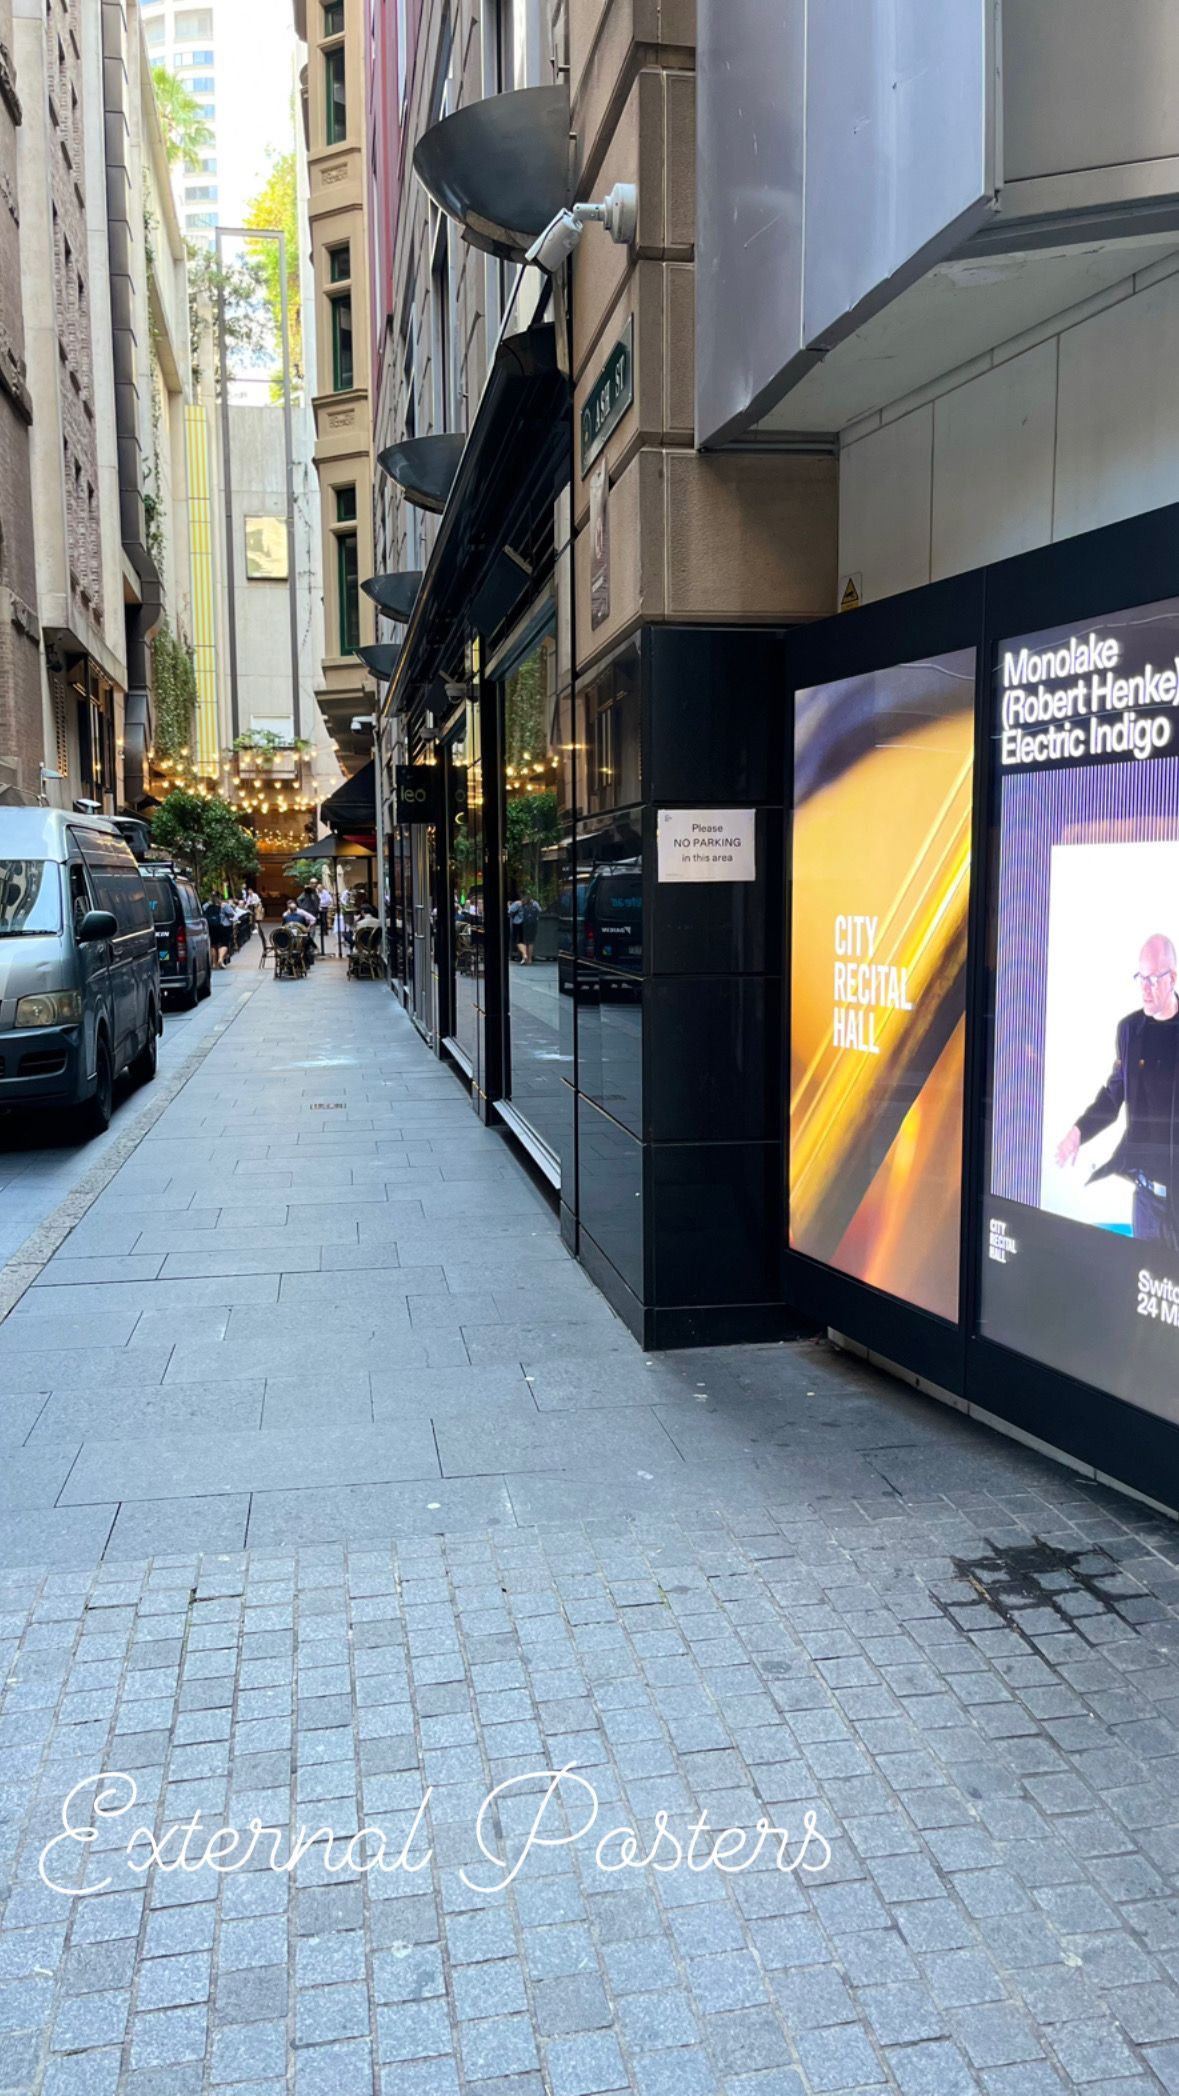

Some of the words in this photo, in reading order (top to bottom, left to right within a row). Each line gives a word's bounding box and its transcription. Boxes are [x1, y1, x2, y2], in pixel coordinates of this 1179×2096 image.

[595, 379, 611, 433] ASH
[615, 354, 625, 399] ST
[1004, 632, 1119, 688] Monolake
[1002, 679, 1087, 731] (Robert
[1001, 720, 1085, 765] Electric
[1090, 712, 1171, 760] Indigo
[400, 785, 427, 803] leo
[673, 838, 690, 847] NO
[693, 838, 741, 847] PARKING
[692, 823, 723, 832] Please
[682, 853, 691, 862] in
[693, 852, 710, 862] this
[712, 854, 733, 862] area
[834, 914, 878, 958] CITY
[833, 961, 913, 1011] RECITAL
[833, 1007, 880, 1054] HALL
[1136, 1292, 1159, 1318] 24
[1161, 1300, 1179, 1328] M
